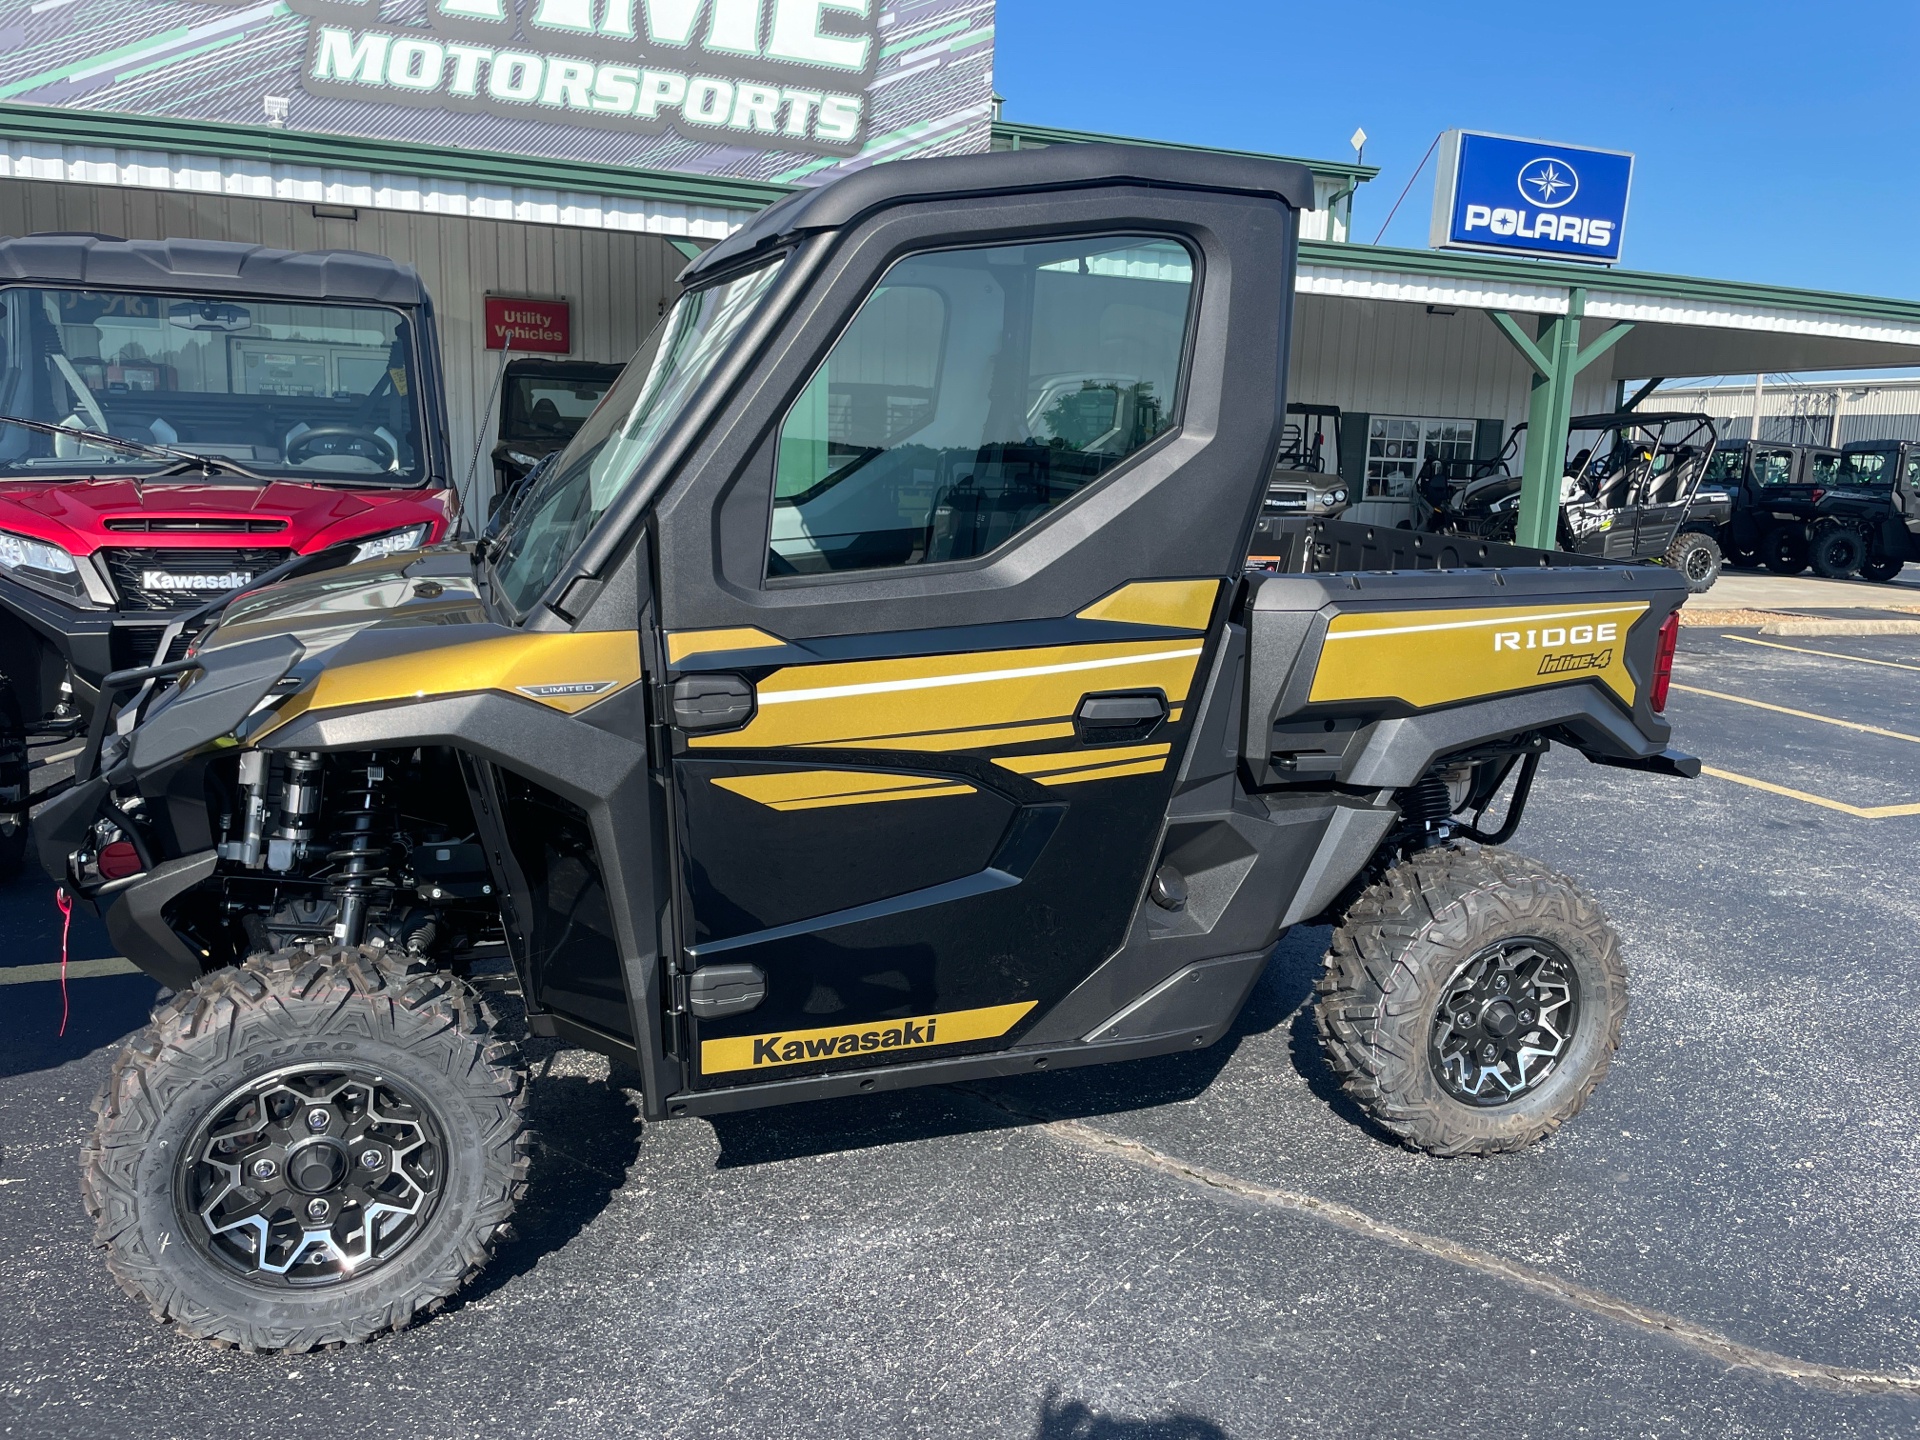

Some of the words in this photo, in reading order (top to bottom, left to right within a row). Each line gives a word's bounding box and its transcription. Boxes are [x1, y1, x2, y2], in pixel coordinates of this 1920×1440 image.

[314, 28, 862, 141] MOTORSPORTS
[1465, 204, 1611, 247] POLARIS
[494, 324, 562, 341] Vehicles
[504, 310, 552, 327] Utility
[143, 571, 252, 589] Kawasaki
[1494, 622, 1617, 651] RIDGE
[1536, 648, 1613, 675] Inline-4
[541, 684, 594, 694] LIMITED
[753, 1018, 937, 1065] Kawasaki
[242, 1041, 357, 1071] DURO
